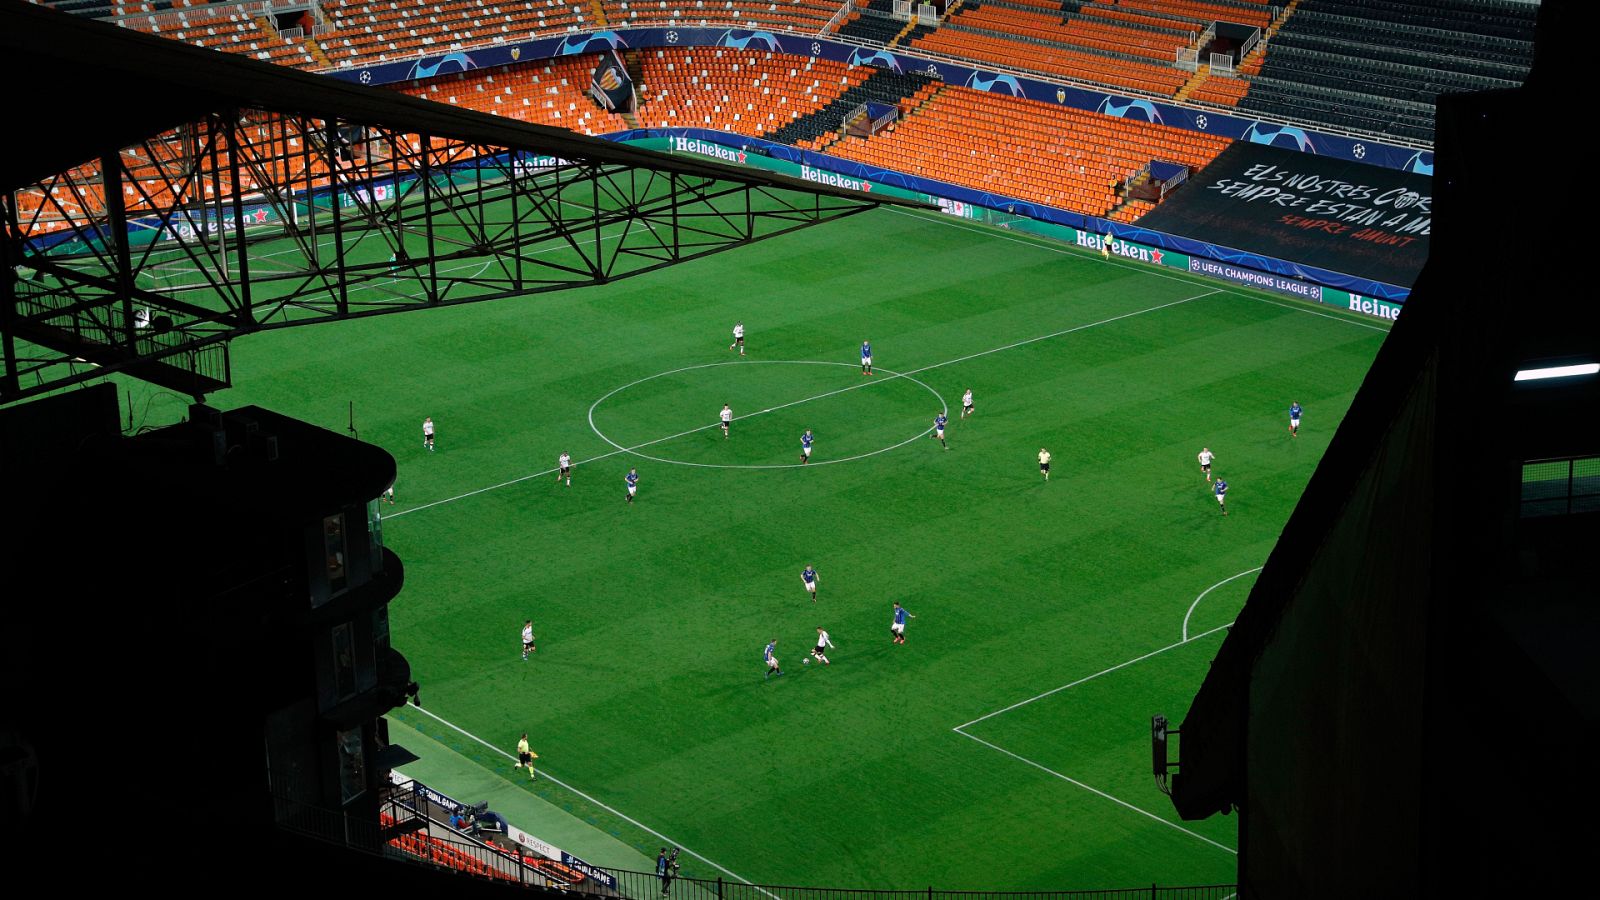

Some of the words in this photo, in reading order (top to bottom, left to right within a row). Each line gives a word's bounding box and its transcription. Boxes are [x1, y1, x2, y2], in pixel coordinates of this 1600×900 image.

[676, 137, 736, 162] Heineken
[801, 165, 860, 191] Heineken
[1244, 164, 1289, 181] ELS
[1282, 173, 1378, 200] NOSTRES
[1207, 179, 1311, 207] SEMPRE
[1305, 200, 1387, 226] ESTAN
[1380, 213, 1408, 227] A
[1277, 214, 1351, 235] SEMPRE
[1349, 228, 1417, 248] AMUNT
[1202, 262, 1223, 276] UEFA
[1225, 268, 1274, 287] CHAMPIONS
[1276, 279, 1308, 295] LEAGUE
[526, 837, 551, 855] RESPECT
[593, 869, 611, 885] GAME
